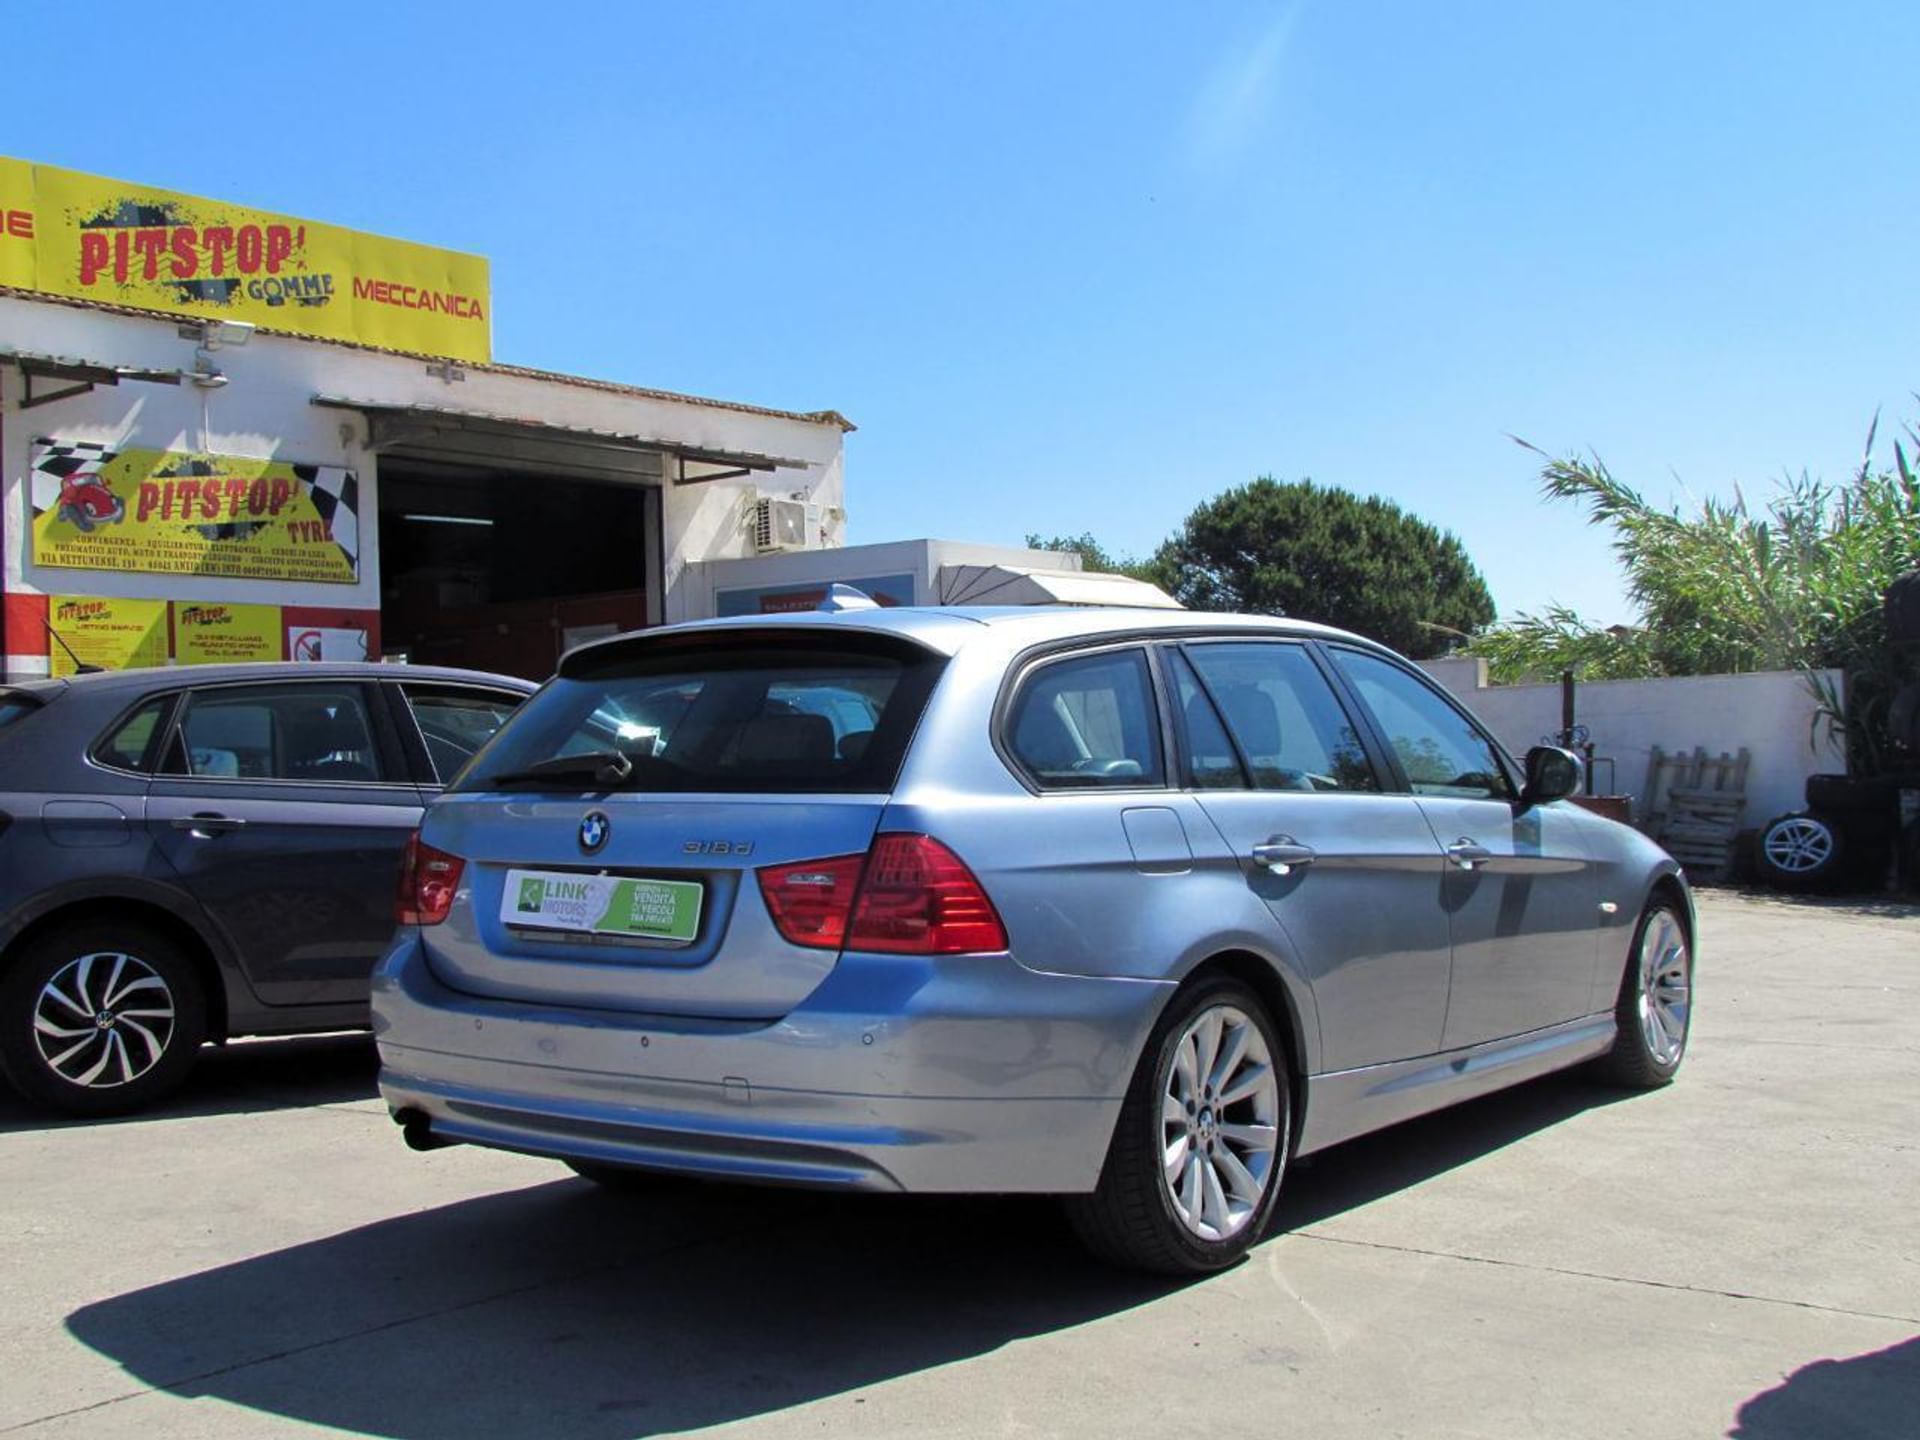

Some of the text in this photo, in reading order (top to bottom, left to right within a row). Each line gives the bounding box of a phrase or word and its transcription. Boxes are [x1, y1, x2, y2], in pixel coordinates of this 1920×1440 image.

[0, 208, 35, 240] E
[247, 273, 336, 301] GOMME
[352, 276, 484, 321] MECCANICA
[287, 518, 335, 544] TYRE
[40, 553, 56, 564] VIA
[545, 881, 589, 900] LINK
[542, 899, 587, 917] MOTORS
